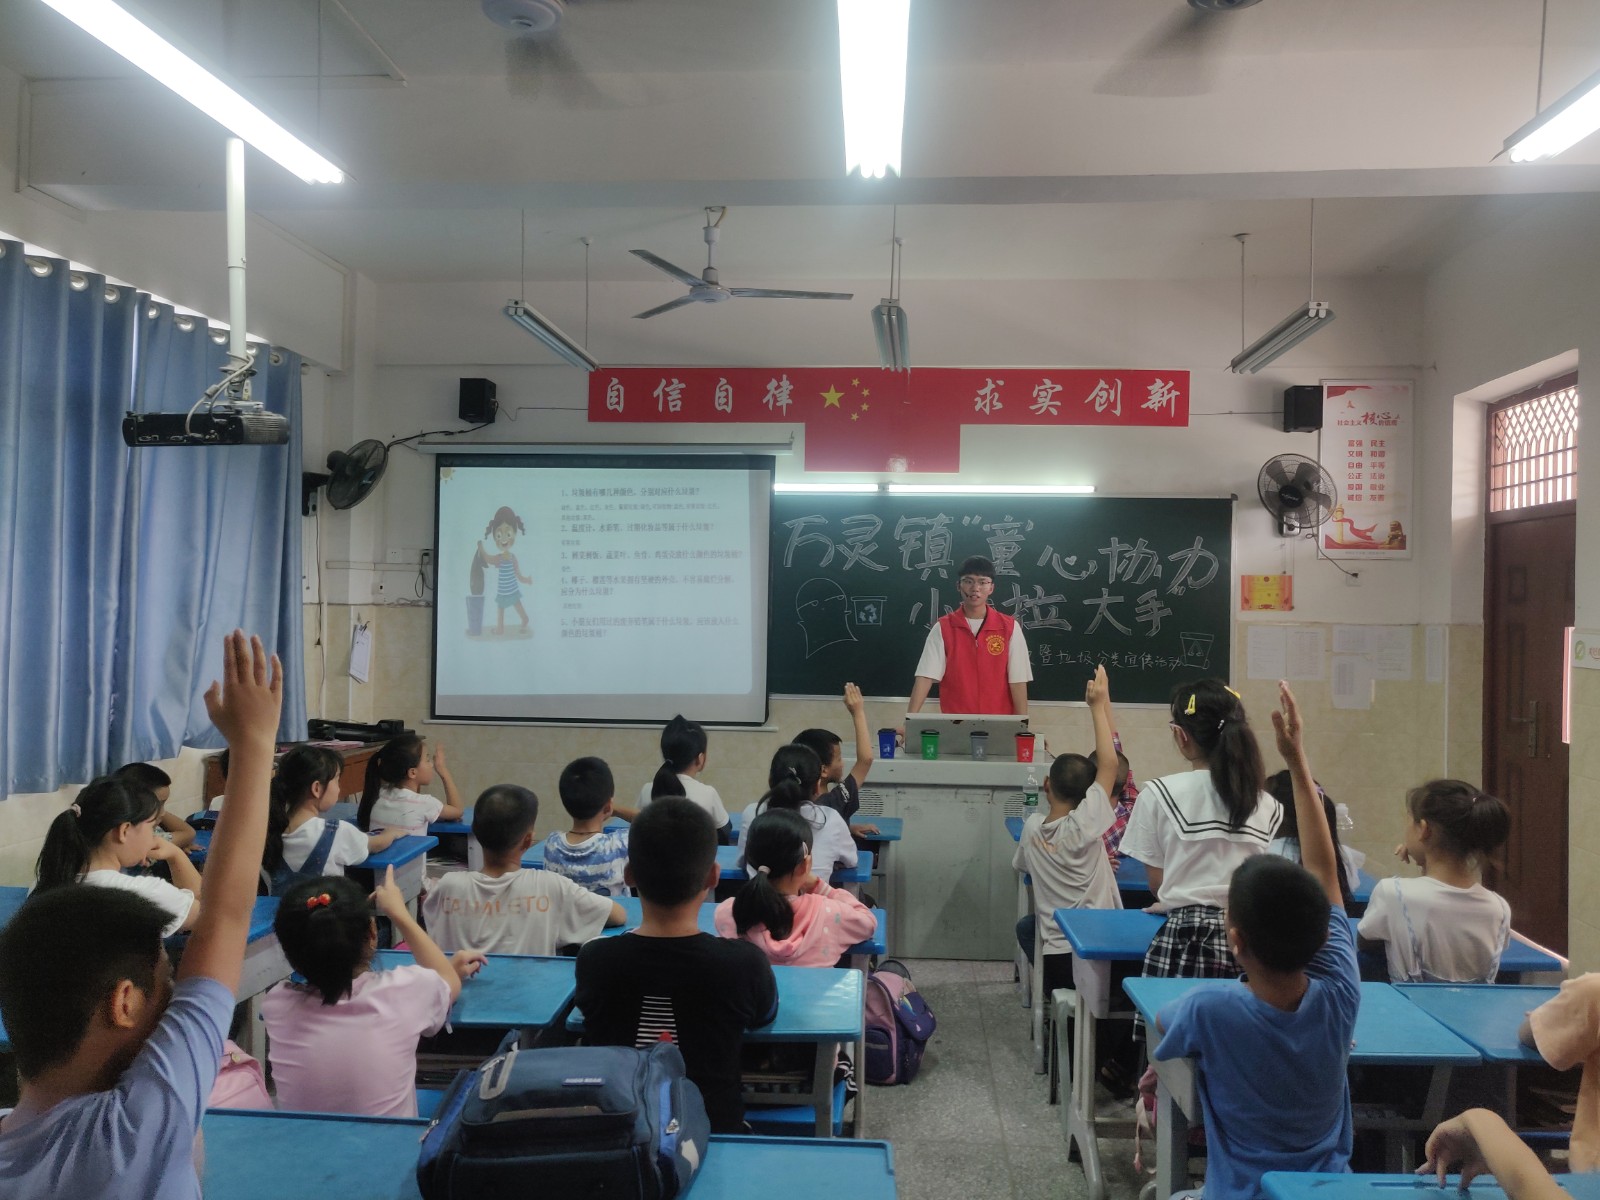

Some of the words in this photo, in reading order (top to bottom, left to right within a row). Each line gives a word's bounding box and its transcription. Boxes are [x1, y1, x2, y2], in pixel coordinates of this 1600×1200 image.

[605, 374, 794, 416] 自信自律
[973, 376, 1181, 418] 求实创新
[1347, 472, 1363, 480] 公正
[1370, 472, 1385, 480] 法治
[909, 583, 1173, 638] 小拉大手
